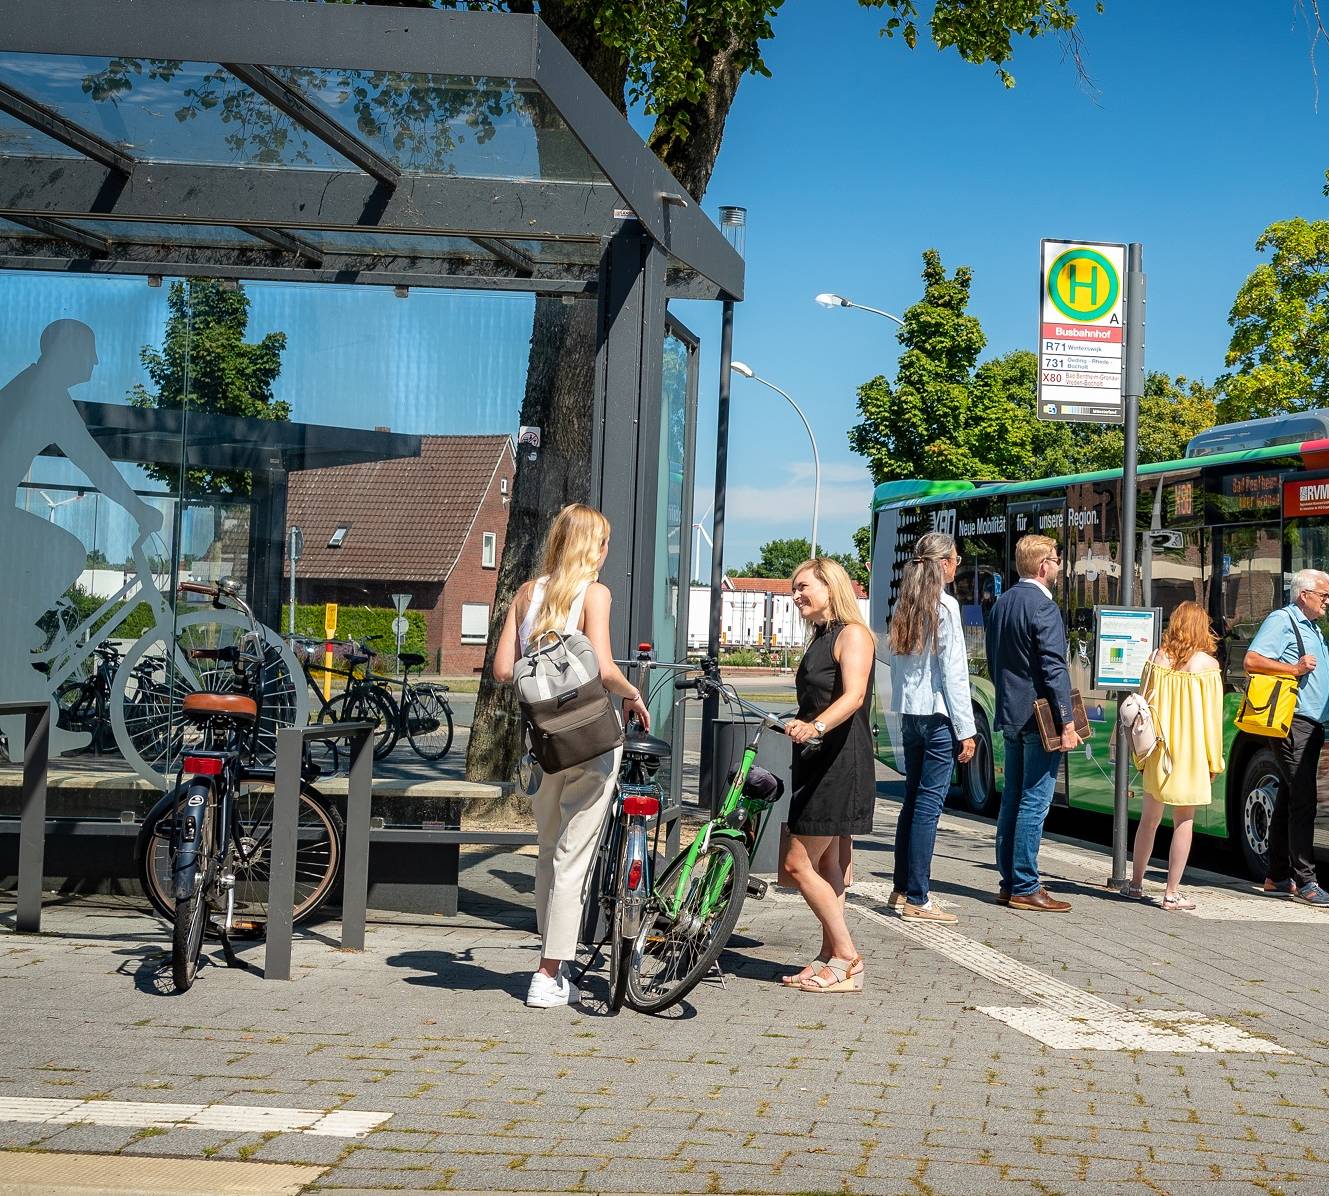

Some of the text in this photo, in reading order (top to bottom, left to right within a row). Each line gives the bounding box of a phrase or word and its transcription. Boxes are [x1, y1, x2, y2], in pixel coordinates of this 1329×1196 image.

[1069, 263, 1098, 306] H
[1109, 312, 1119, 324] A
[1055, 327, 1111, 338] Busbahnhof
[1046, 341, 1066, 351] R71
[1045, 358, 1064, 368] 731
[1043, 373, 1062, 383] X80
[1307, 483, 1329, 500] RVM
[959, 519, 976, 537] Neue
[976, 515, 1006, 535] Mobilität
[1016, 513, 1028, 531] für
[1039, 514, 1064, 529] unsere
[1068, 508, 1099, 530] Region.
